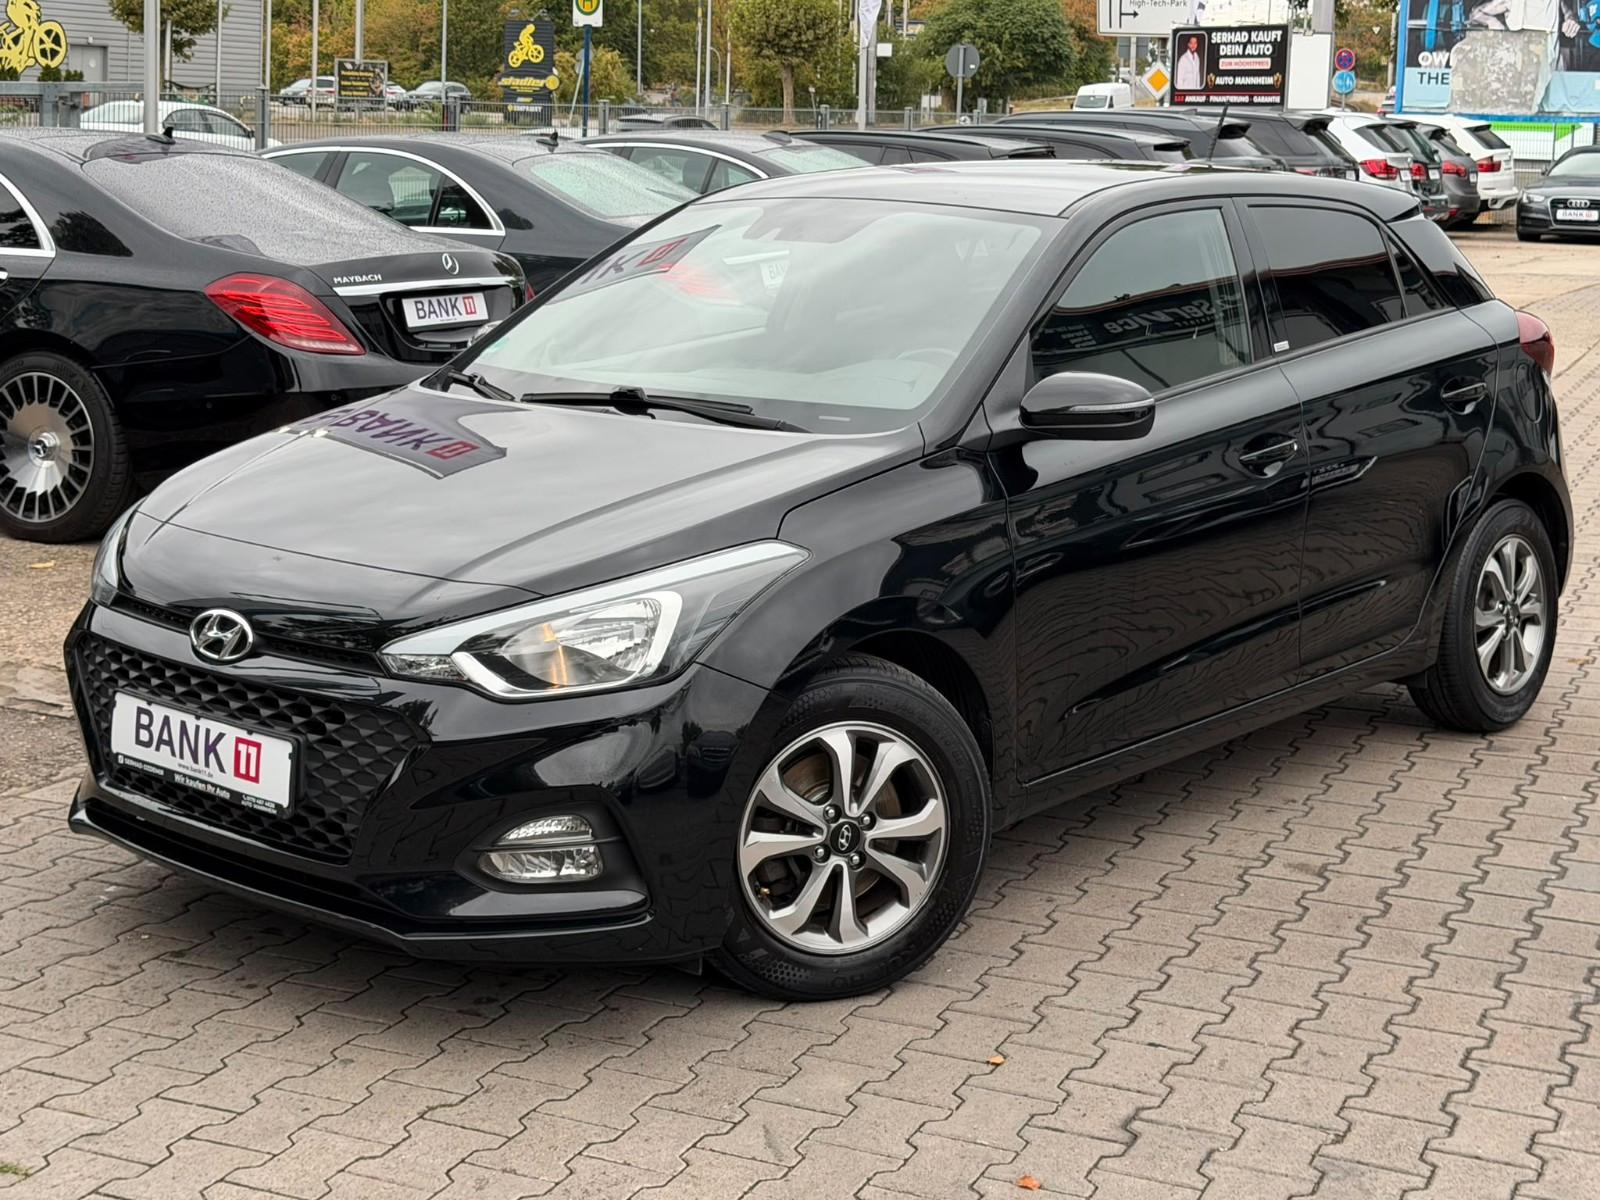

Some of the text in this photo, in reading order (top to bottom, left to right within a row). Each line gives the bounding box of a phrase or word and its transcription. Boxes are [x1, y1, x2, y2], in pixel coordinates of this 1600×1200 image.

[1129, 0, 1187, 8] High-Tech-Park
[1211, 30, 1283, 43] SERHAD KAUFT
[1219, 44, 1273, 56] DEIN AUTO
[1418, 51, 1453, 67] OW
[1215, 76, 1274, 86] AUTO MANNHEIM
[1417, 71, 1450, 85] THE
[333, 273, 383, 284] MAYBACH
[415, 297, 476, 320] BANK 11
[135, 706, 259, 780] BANK 11
[174, 773, 186, 784] Wir
[186, 776, 206, 791] kaufen
[215, 786, 230, 800] Auto
